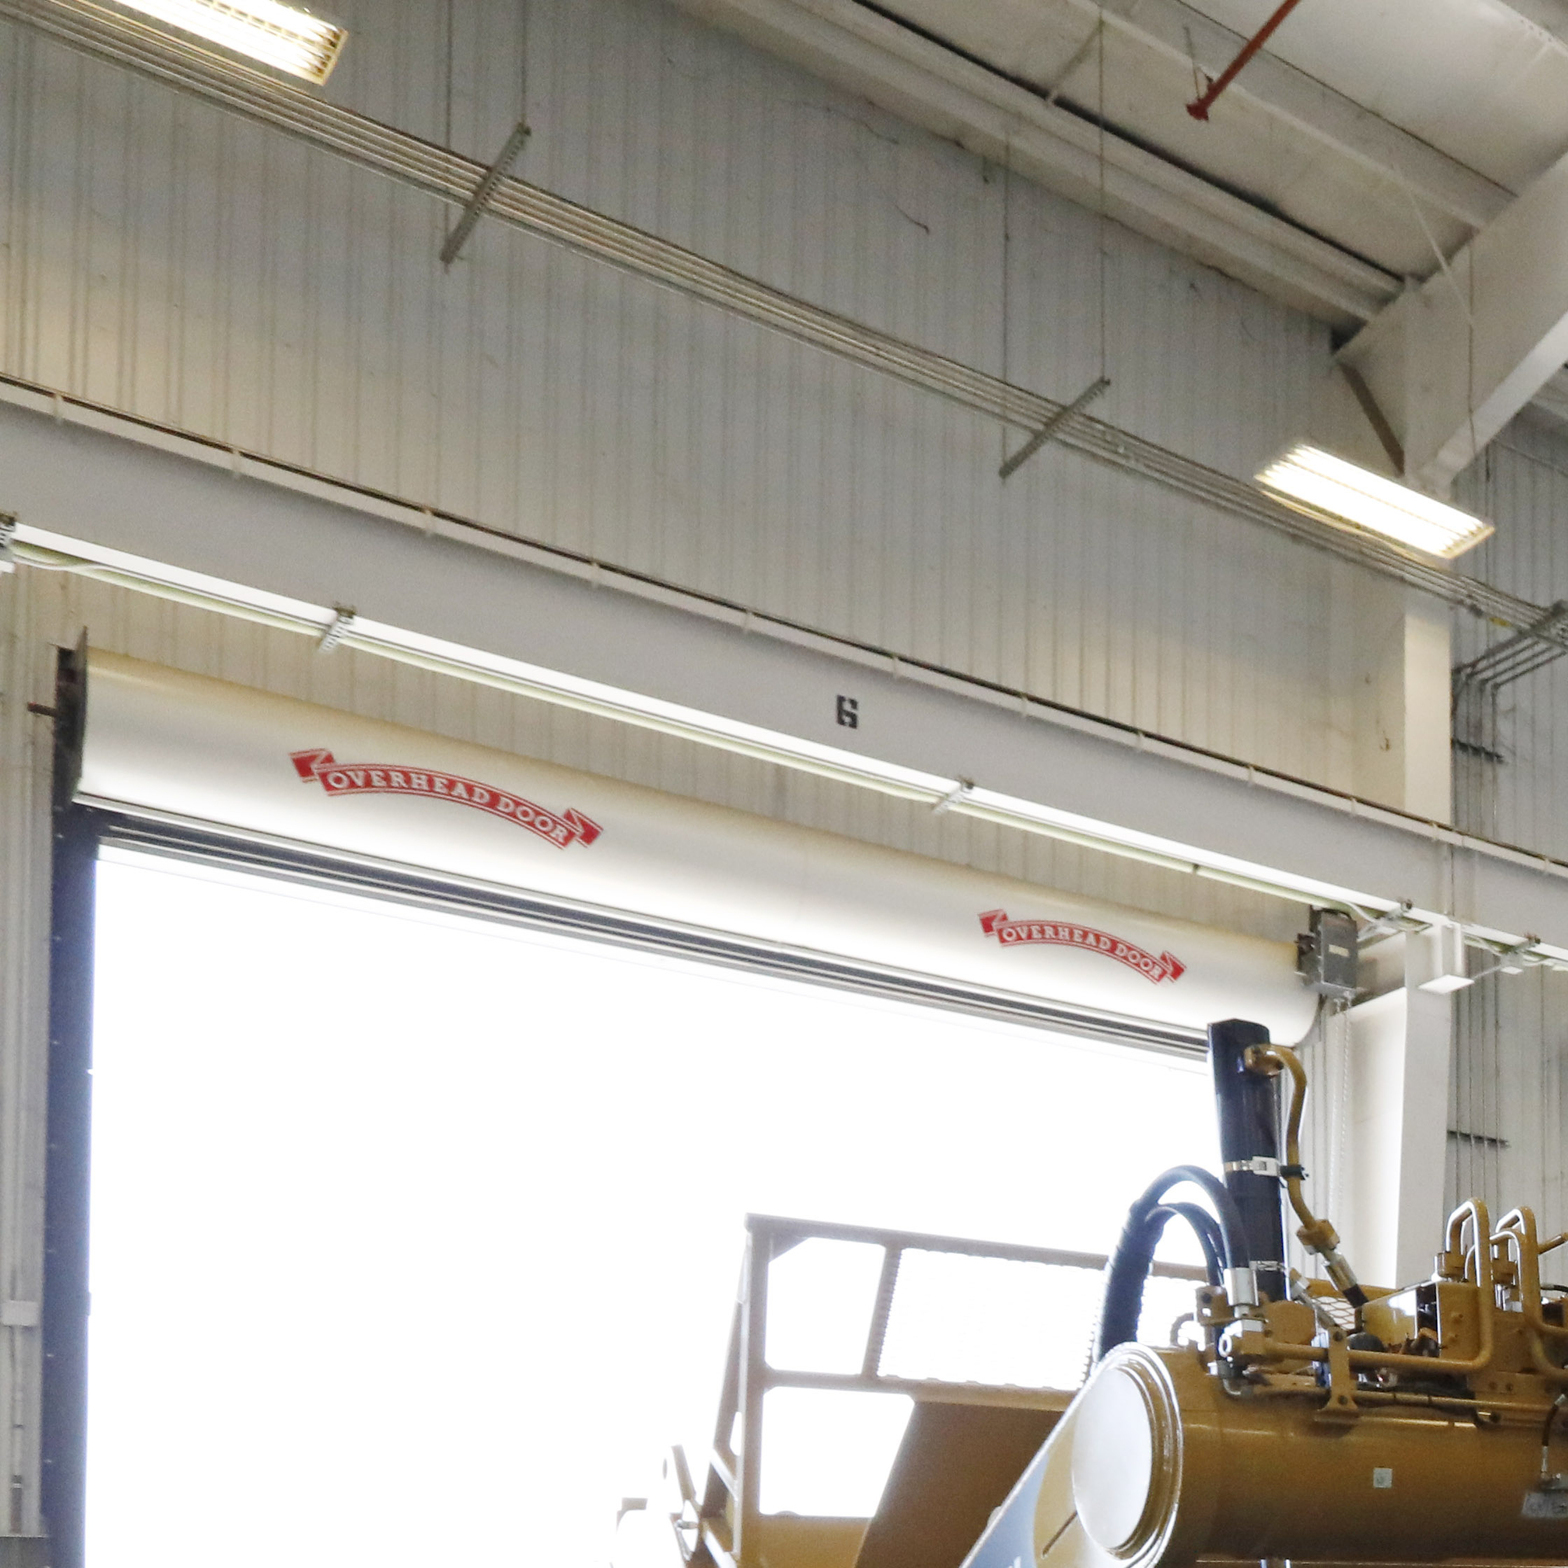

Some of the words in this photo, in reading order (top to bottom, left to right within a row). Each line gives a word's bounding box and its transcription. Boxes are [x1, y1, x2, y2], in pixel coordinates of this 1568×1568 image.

[836, 694, 858, 729] 6
[328, 770, 491, 804] OVERHEAD
[496, 795, 568, 844] DOOR
[1002, 924, 1112, 950] OVERHEAD
[1114, 945, 1163, 979] DOOR
